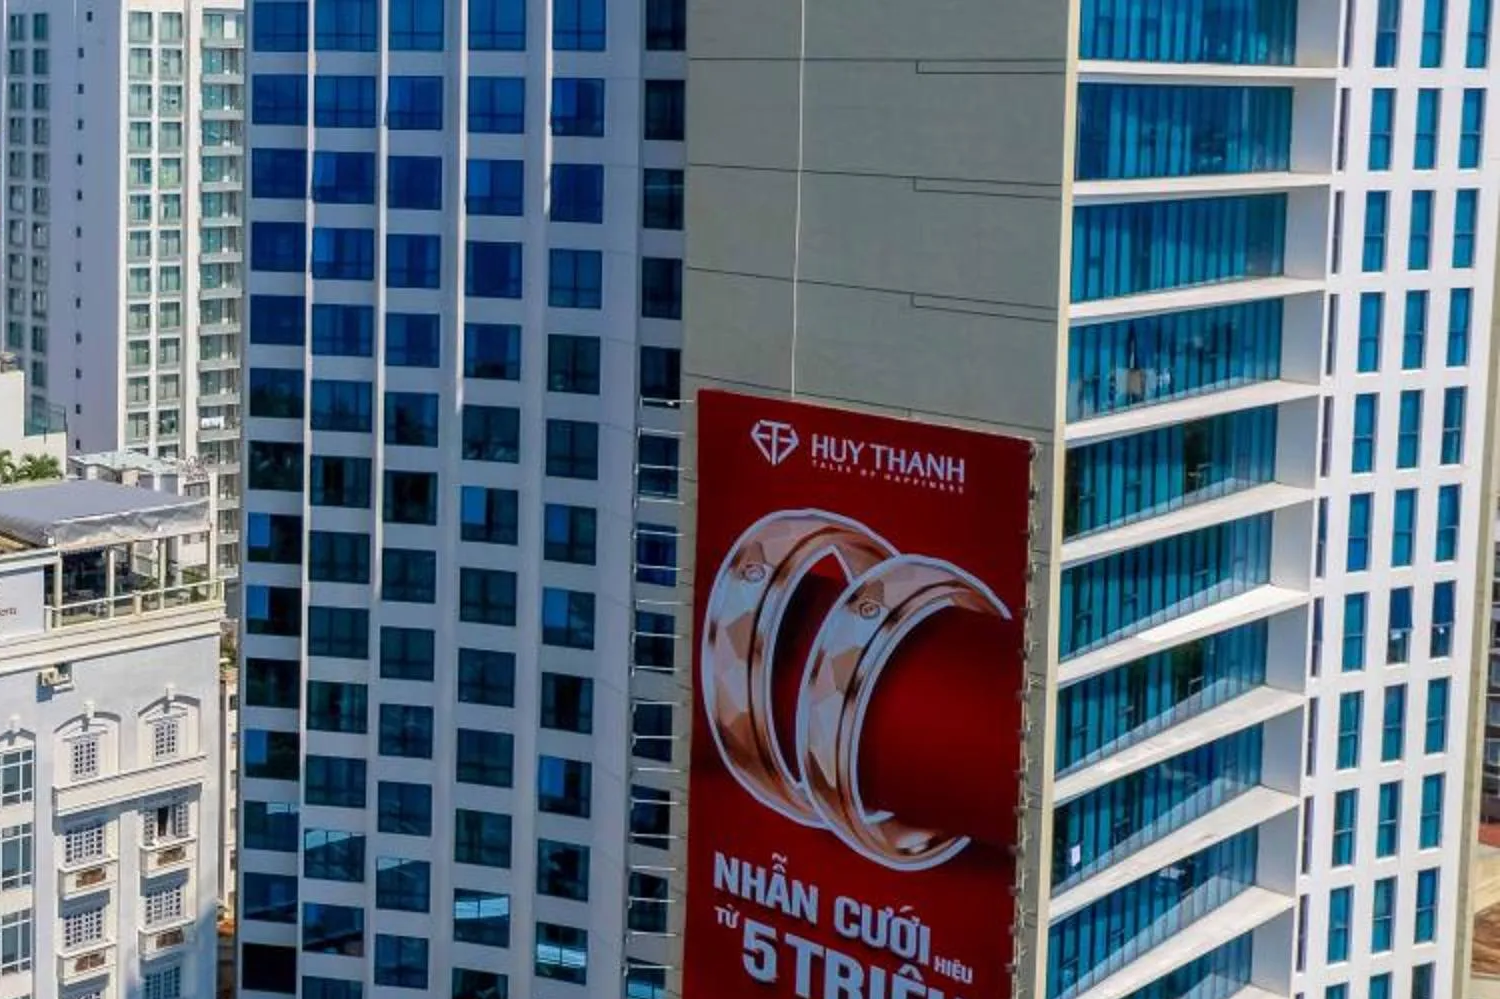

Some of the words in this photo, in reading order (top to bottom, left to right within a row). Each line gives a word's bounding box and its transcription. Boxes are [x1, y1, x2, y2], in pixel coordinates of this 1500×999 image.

[811, 433, 865, 465] HUY
[869, 443, 965, 483] THANH
[713, 851, 819, 925] NHẪN
[833, 895, 931, 966] CƯỚI
[742, 916, 779, 983] 5
